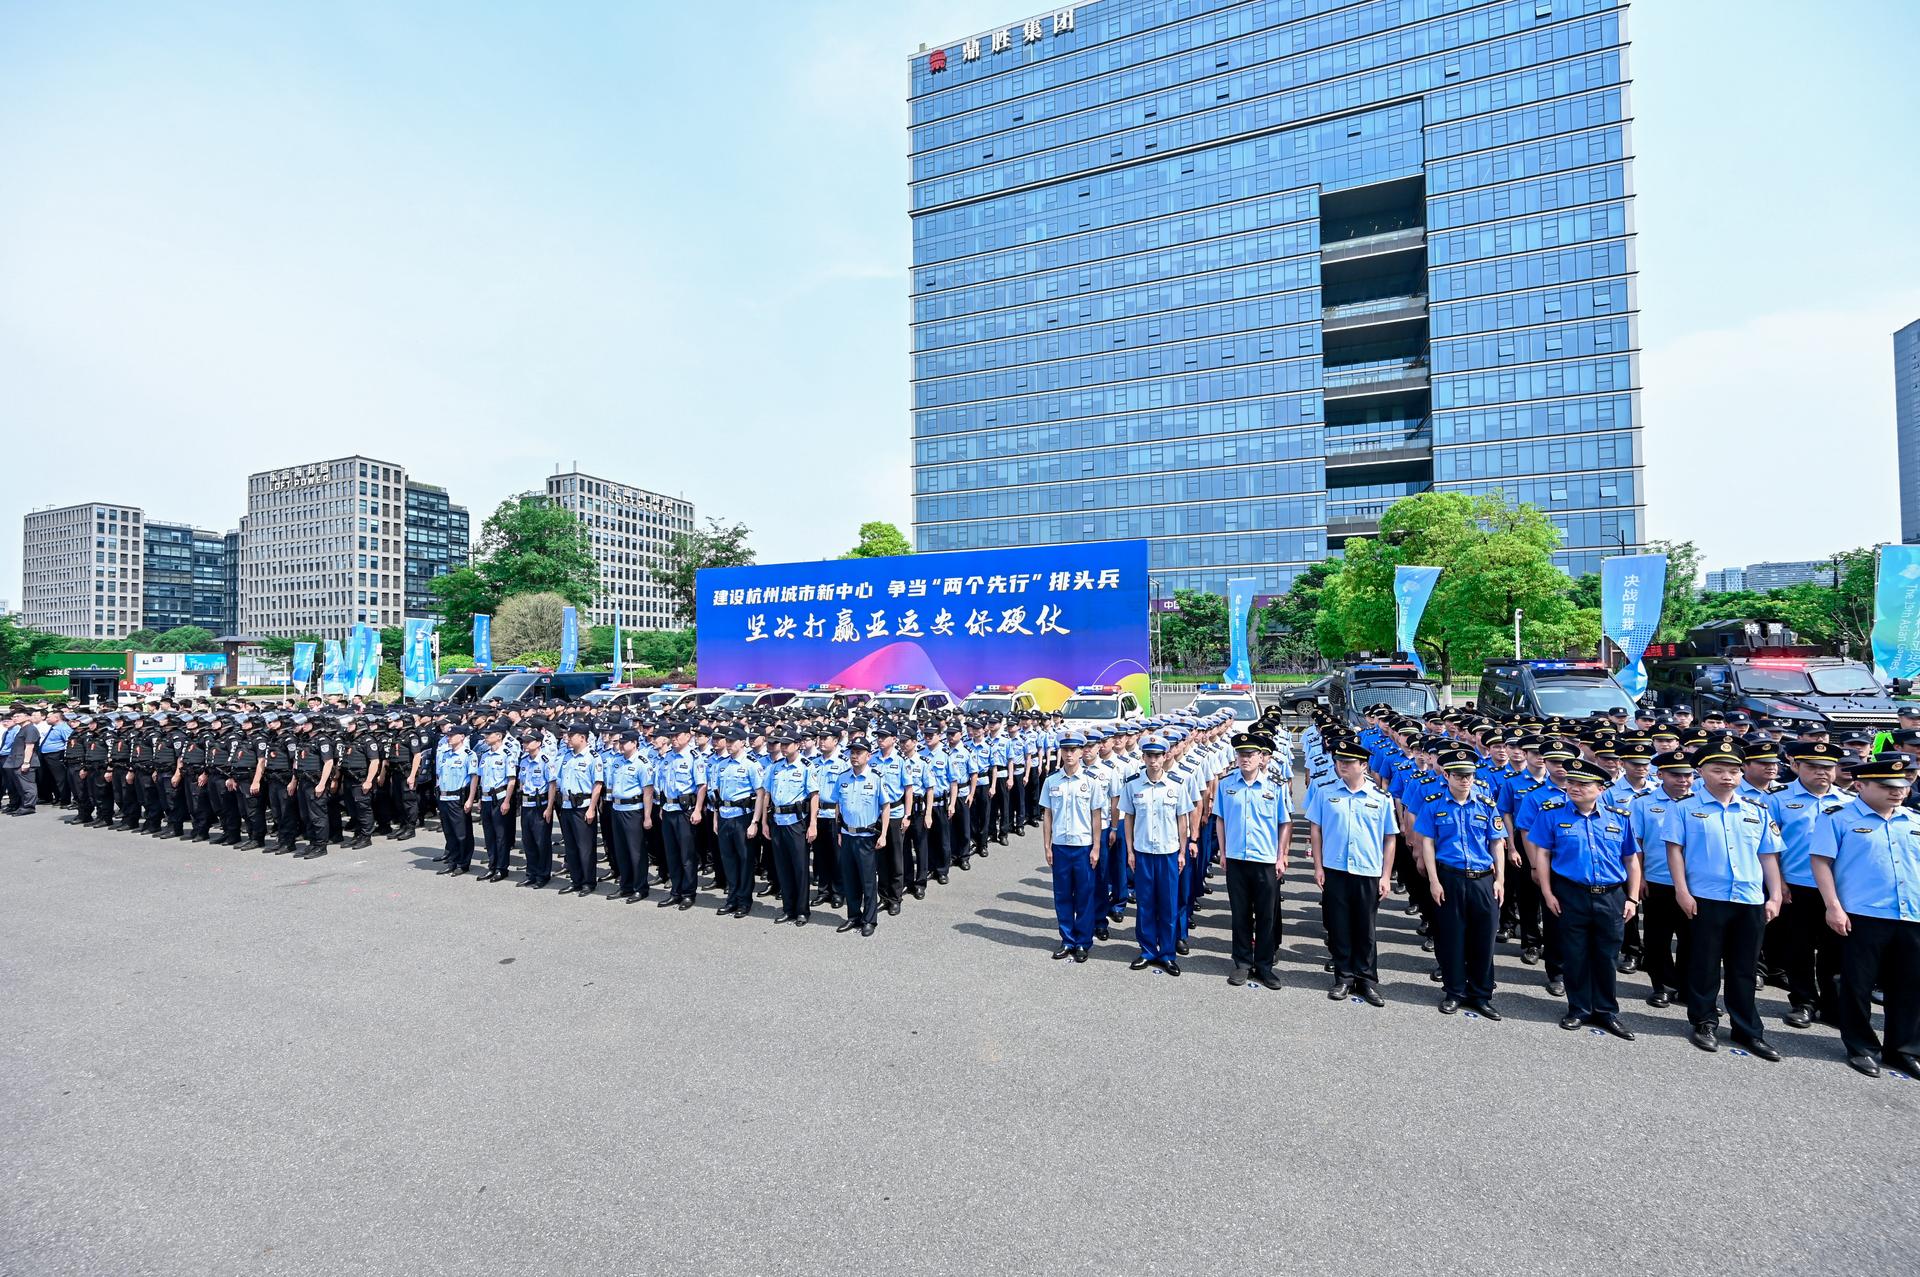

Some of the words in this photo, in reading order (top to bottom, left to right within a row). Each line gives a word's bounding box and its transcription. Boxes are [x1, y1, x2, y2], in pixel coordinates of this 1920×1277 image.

[963, 9, 1074, 61] 鼎胜集团
[270, 481, 290, 491] LOFT
[294, 475, 329, 487] POWER
[713, 582, 873, 606] 建设杭州城市新中心
[1905, 584, 1918, 599] The
[1902, 599, 1914, 618] 19th
[745, 604, 1071, 642] 坚决打赢亚运安保硬仗
[1745, 623, 1782, 634] 特警
[1898, 618, 1911, 641] Asian
[1890, 643, 1904, 670] Games
